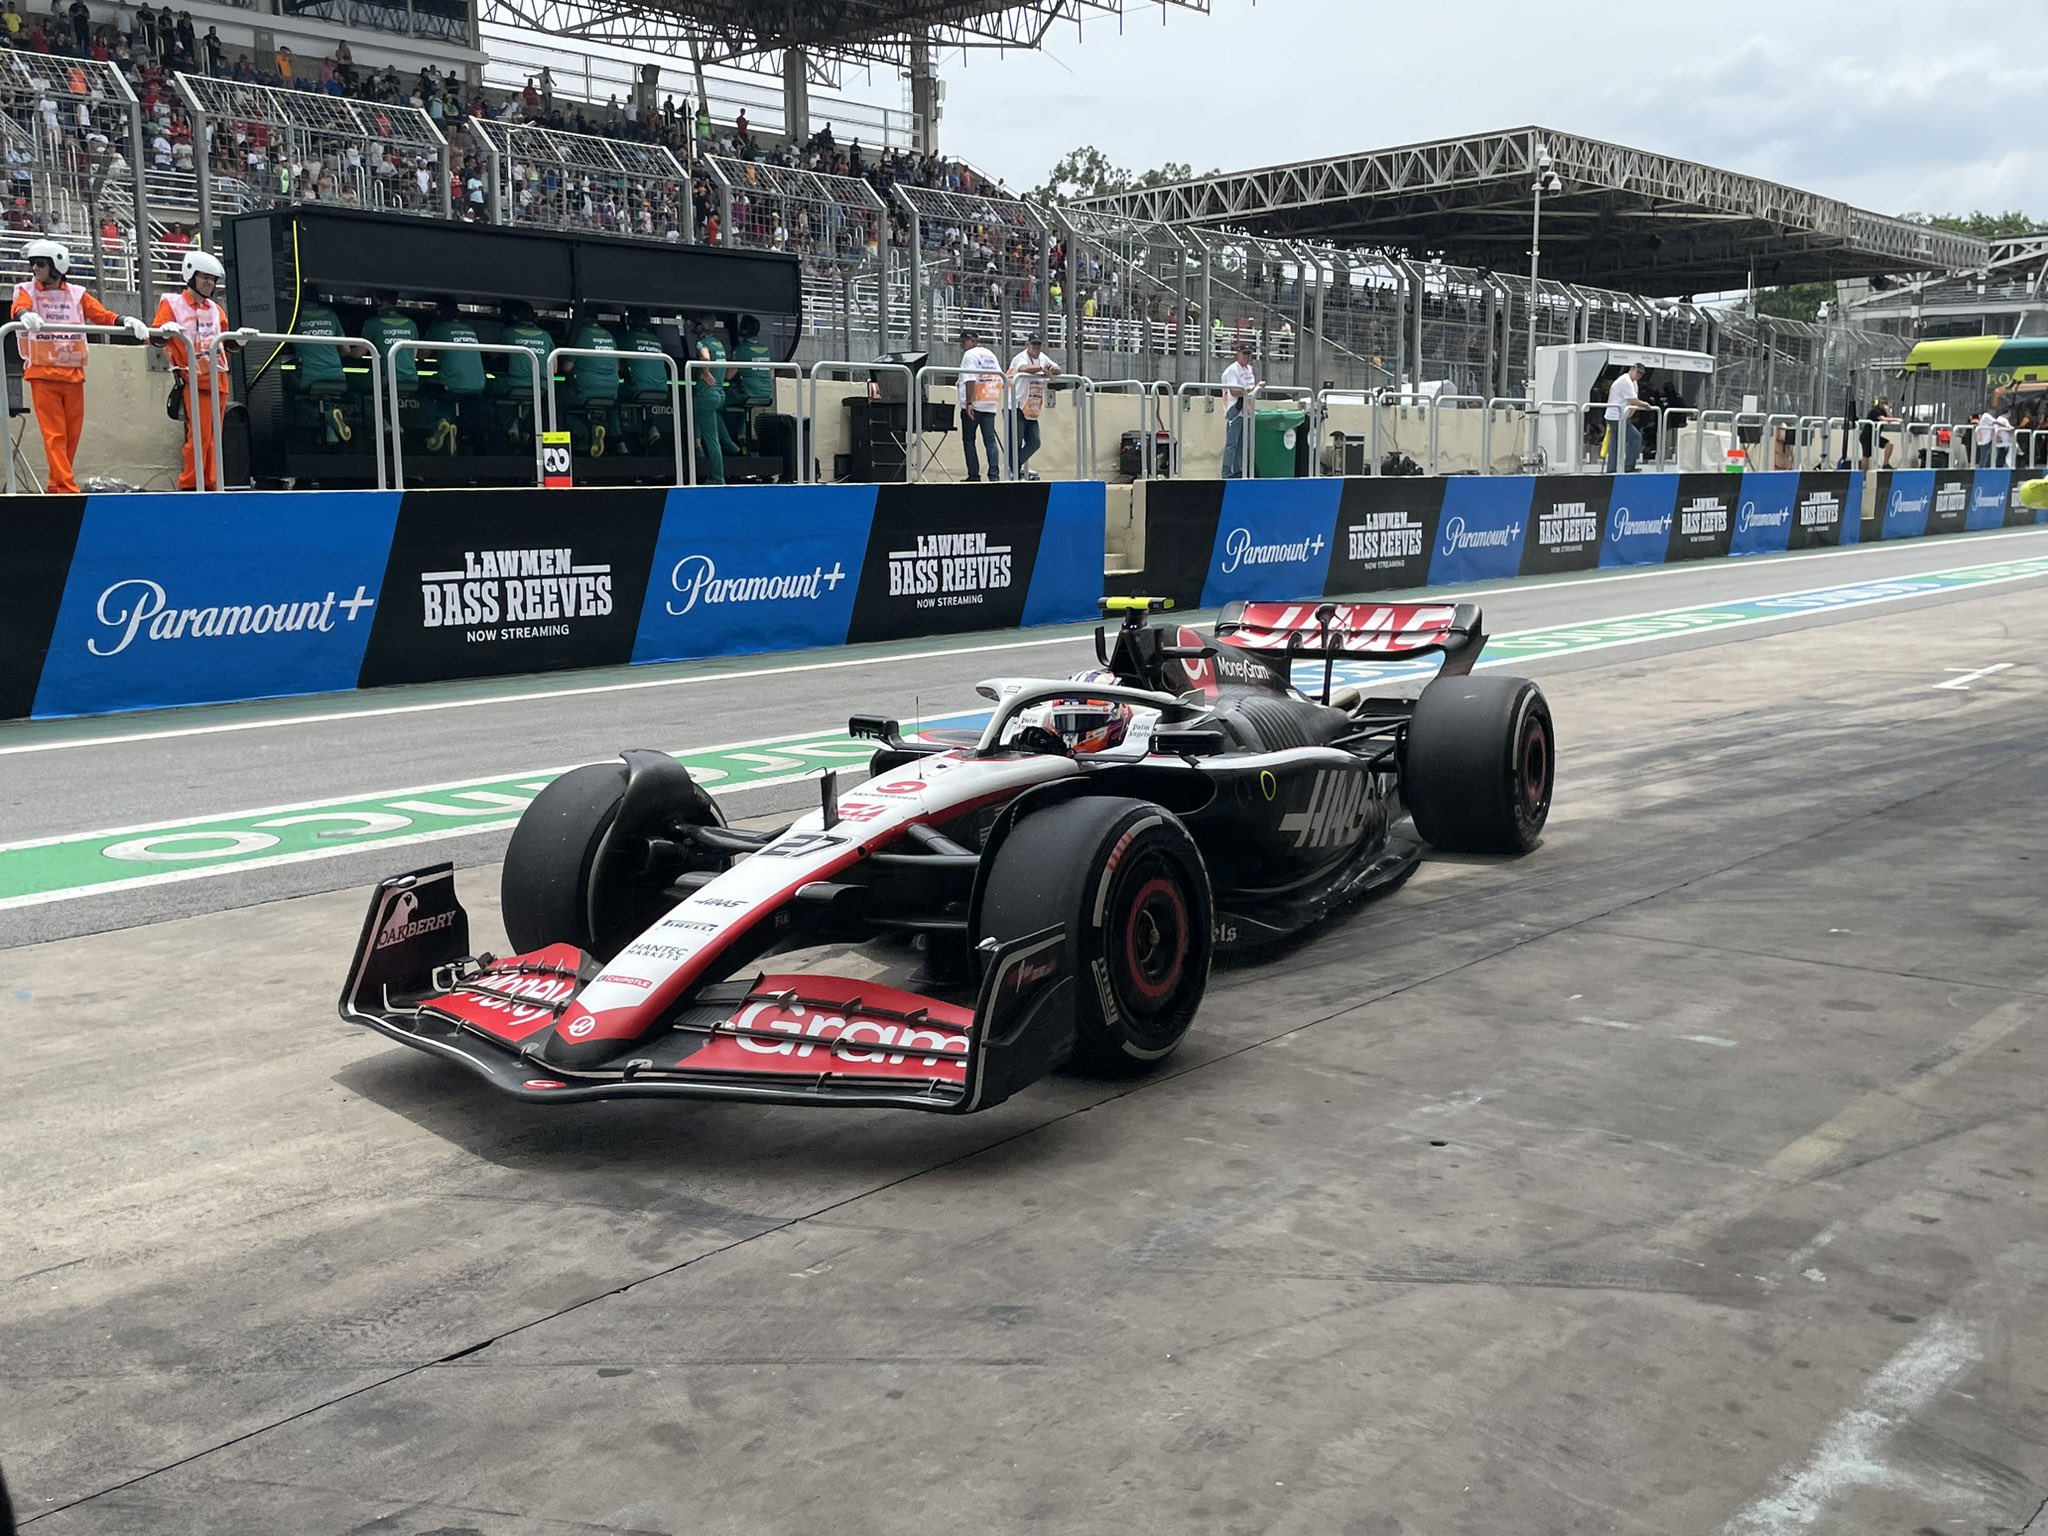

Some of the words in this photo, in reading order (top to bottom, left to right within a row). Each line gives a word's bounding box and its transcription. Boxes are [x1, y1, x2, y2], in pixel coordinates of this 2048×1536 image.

[1365, 511, 1408, 531] LAWMEN
[1538, 520, 1563, 545] BASS
[1563, 517, 1597, 543] REEVES
[1611, 507, 1673, 542] Paramount+
[917, 532, 987, 558] LAWMEN
[1221, 527, 1325, 574] Paramount+
[1348, 532, 1379, 561] BASS
[1380, 529, 1423, 557] REEVES
[1442, 516, 1521, 557] Paramount+
[464, 548, 572, 579] LAWMEN
[888, 559, 939, 597] BASS
[941, 554, 1012, 593] REEVES
[1364, 562, 1377, 570] NOW
[1378, 559, 1406, 569] STREAMING
[665, 554, 846, 616] Paramount+
[421, 581, 500, 628] BASS
[505, 575, 613, 622] REEVES
[916, 599, 936, 609] NOW
[937, 594, 984, 608] STREAMING
[87, 579, 376, 657] Paramount+
[1233, 606, 1451, 651] HAAS
[467, 629, 497, 643] NOW
[501, 624, 570, 641] STREAMING
[1217, 656, 1270, 682] MoneyGram
[101, 741, 881, 862] armco
[758, 834, 854, 858] 27
[693, 898, 749, 908] HAAS
[377, 910, 457, 946] OAKBERRY
[660, 920, 719, 932] PIRELLI
[625, 949, 681, 961] MARKETS
[631, 943, 689, 956] HANTEC
[608, 975, 651, 988] CHIPOTLE
[736, 991, 970, 1068] Gram
